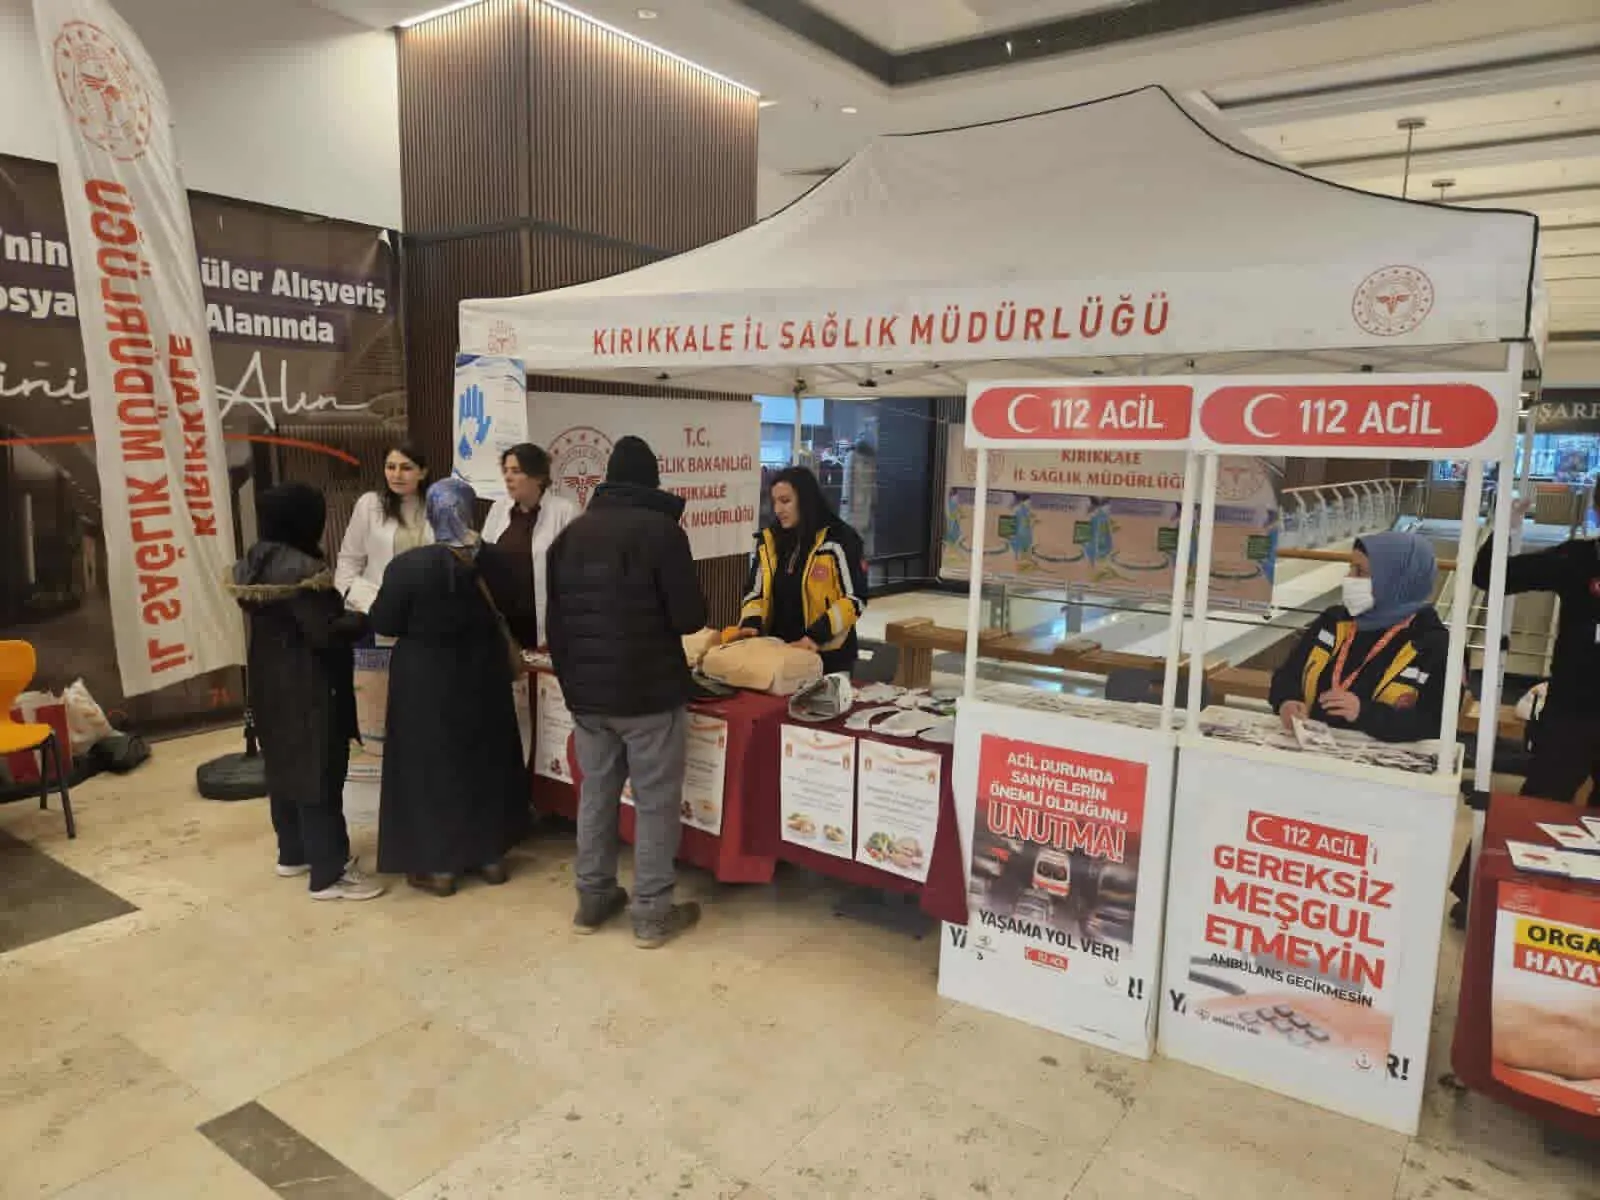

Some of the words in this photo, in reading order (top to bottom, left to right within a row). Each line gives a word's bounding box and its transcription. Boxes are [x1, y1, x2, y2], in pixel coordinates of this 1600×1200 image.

[201, 257, 263, 293] üler
[271, 269, 387, 314] Alışveriş
[206, 303, 335, 344] Alanında
[593, 322, 734, 355] KIRIKKALE
[743, 316, 769, 351] İL
[778, 311, 898, 350] SAĞLIK
[910, 292, 1170, 345] MÜDÜRLÜĞÜ
[1051, 399, 1090, 429] 112
[1098, 393, 1164, 430] ACİL
[1300, 398, 1348, 434] 112
[1359, 394, 1443, 435] ACİL
[683, 427, 711, 447] T.C.
[1061, 449, 1143, 465] KIRIKKALE
[688, 454, 752, 473] BAKANLIĞI
[1030, 467, 1082, 484] SAĞLIK
[1008, 752, 1038, 770] ACİL
[1040, 759, 1114, 784] DURUMDA
[1010, 770, 1107, 801] SANİYELERİN
[991, 780, 1043, 807] ÖNEMLİ
[1045, 795, 1128, 824] OLDUĞUNU
[987, 800, 1127, 863] UNUTMA!
[1281, 824, 1312, 847] 112
[1316, 832, 1361, 859] ACİL
[1213, 844, 1395, 909] GEREKSİZ
[1213, 875, 1386, 948] MEŞGUL
[979, 909, 1042, 941] YAŞAMA
[1044, 927, 1078, 950] YOL
[1081, 937, 1120, 962] VER!
[1204, 913, 1386, 990] ETMEYİN
[1209, 953, 1284, 982] AMBULANS
[1286, 973, 1373, 1007] GECİKMESİN
[1525, 950, 1600, 985] HAYA
